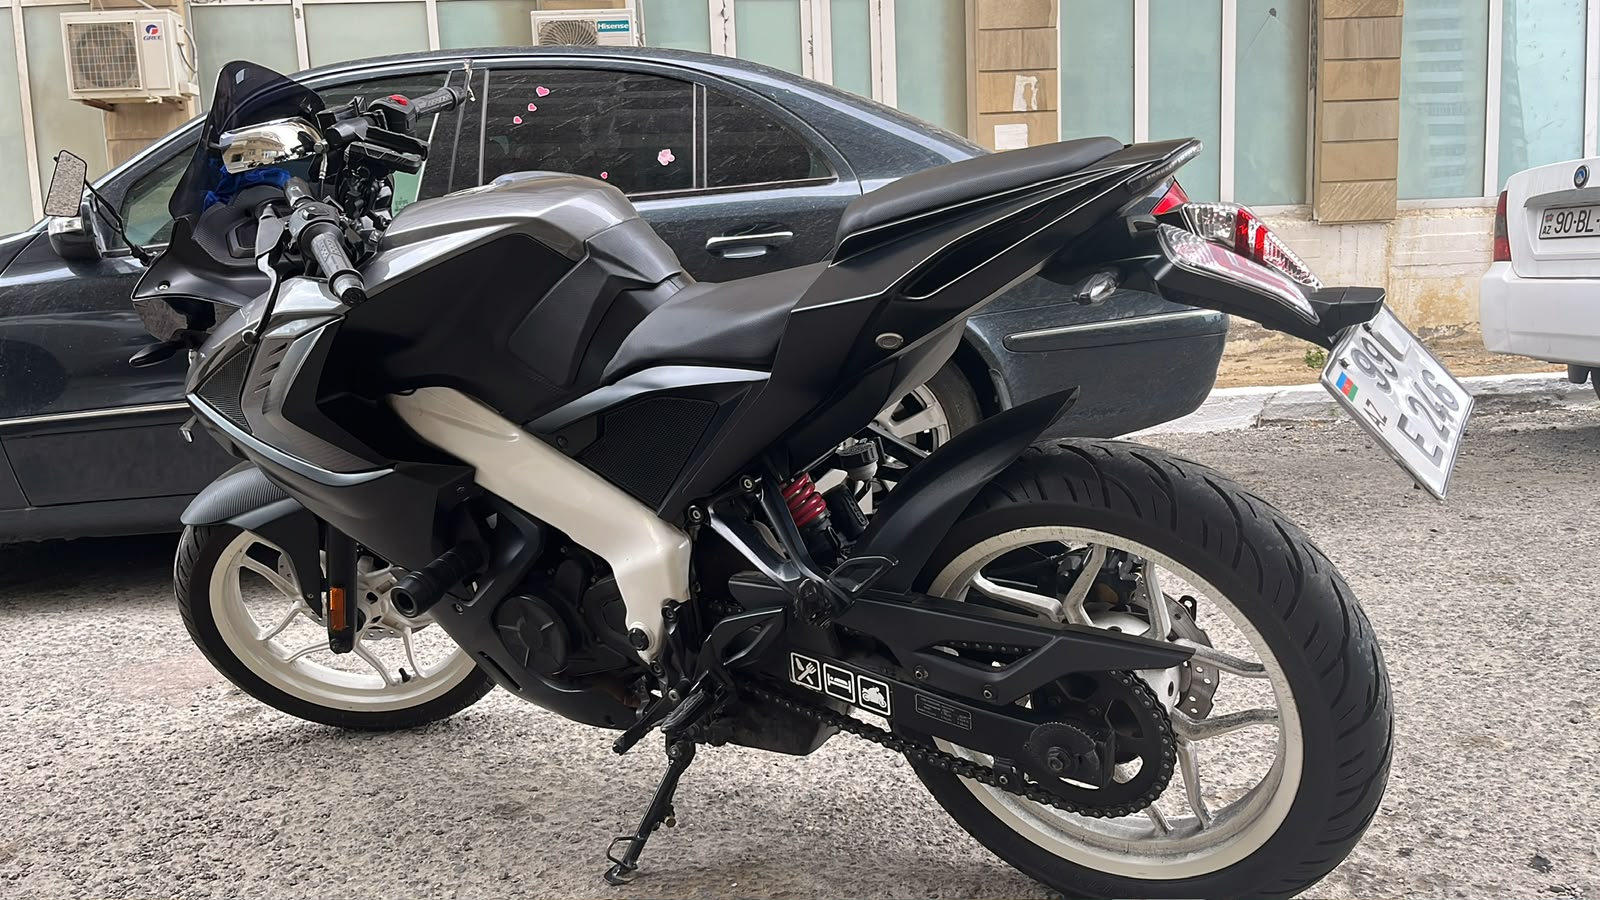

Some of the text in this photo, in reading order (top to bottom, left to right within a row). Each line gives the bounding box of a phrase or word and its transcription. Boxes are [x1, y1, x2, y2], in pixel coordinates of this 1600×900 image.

[1542, 225, 1552, 235] AZ
[1351, 337, 1399, 394] 99
[1363, 398, 1388, 433] AZ
